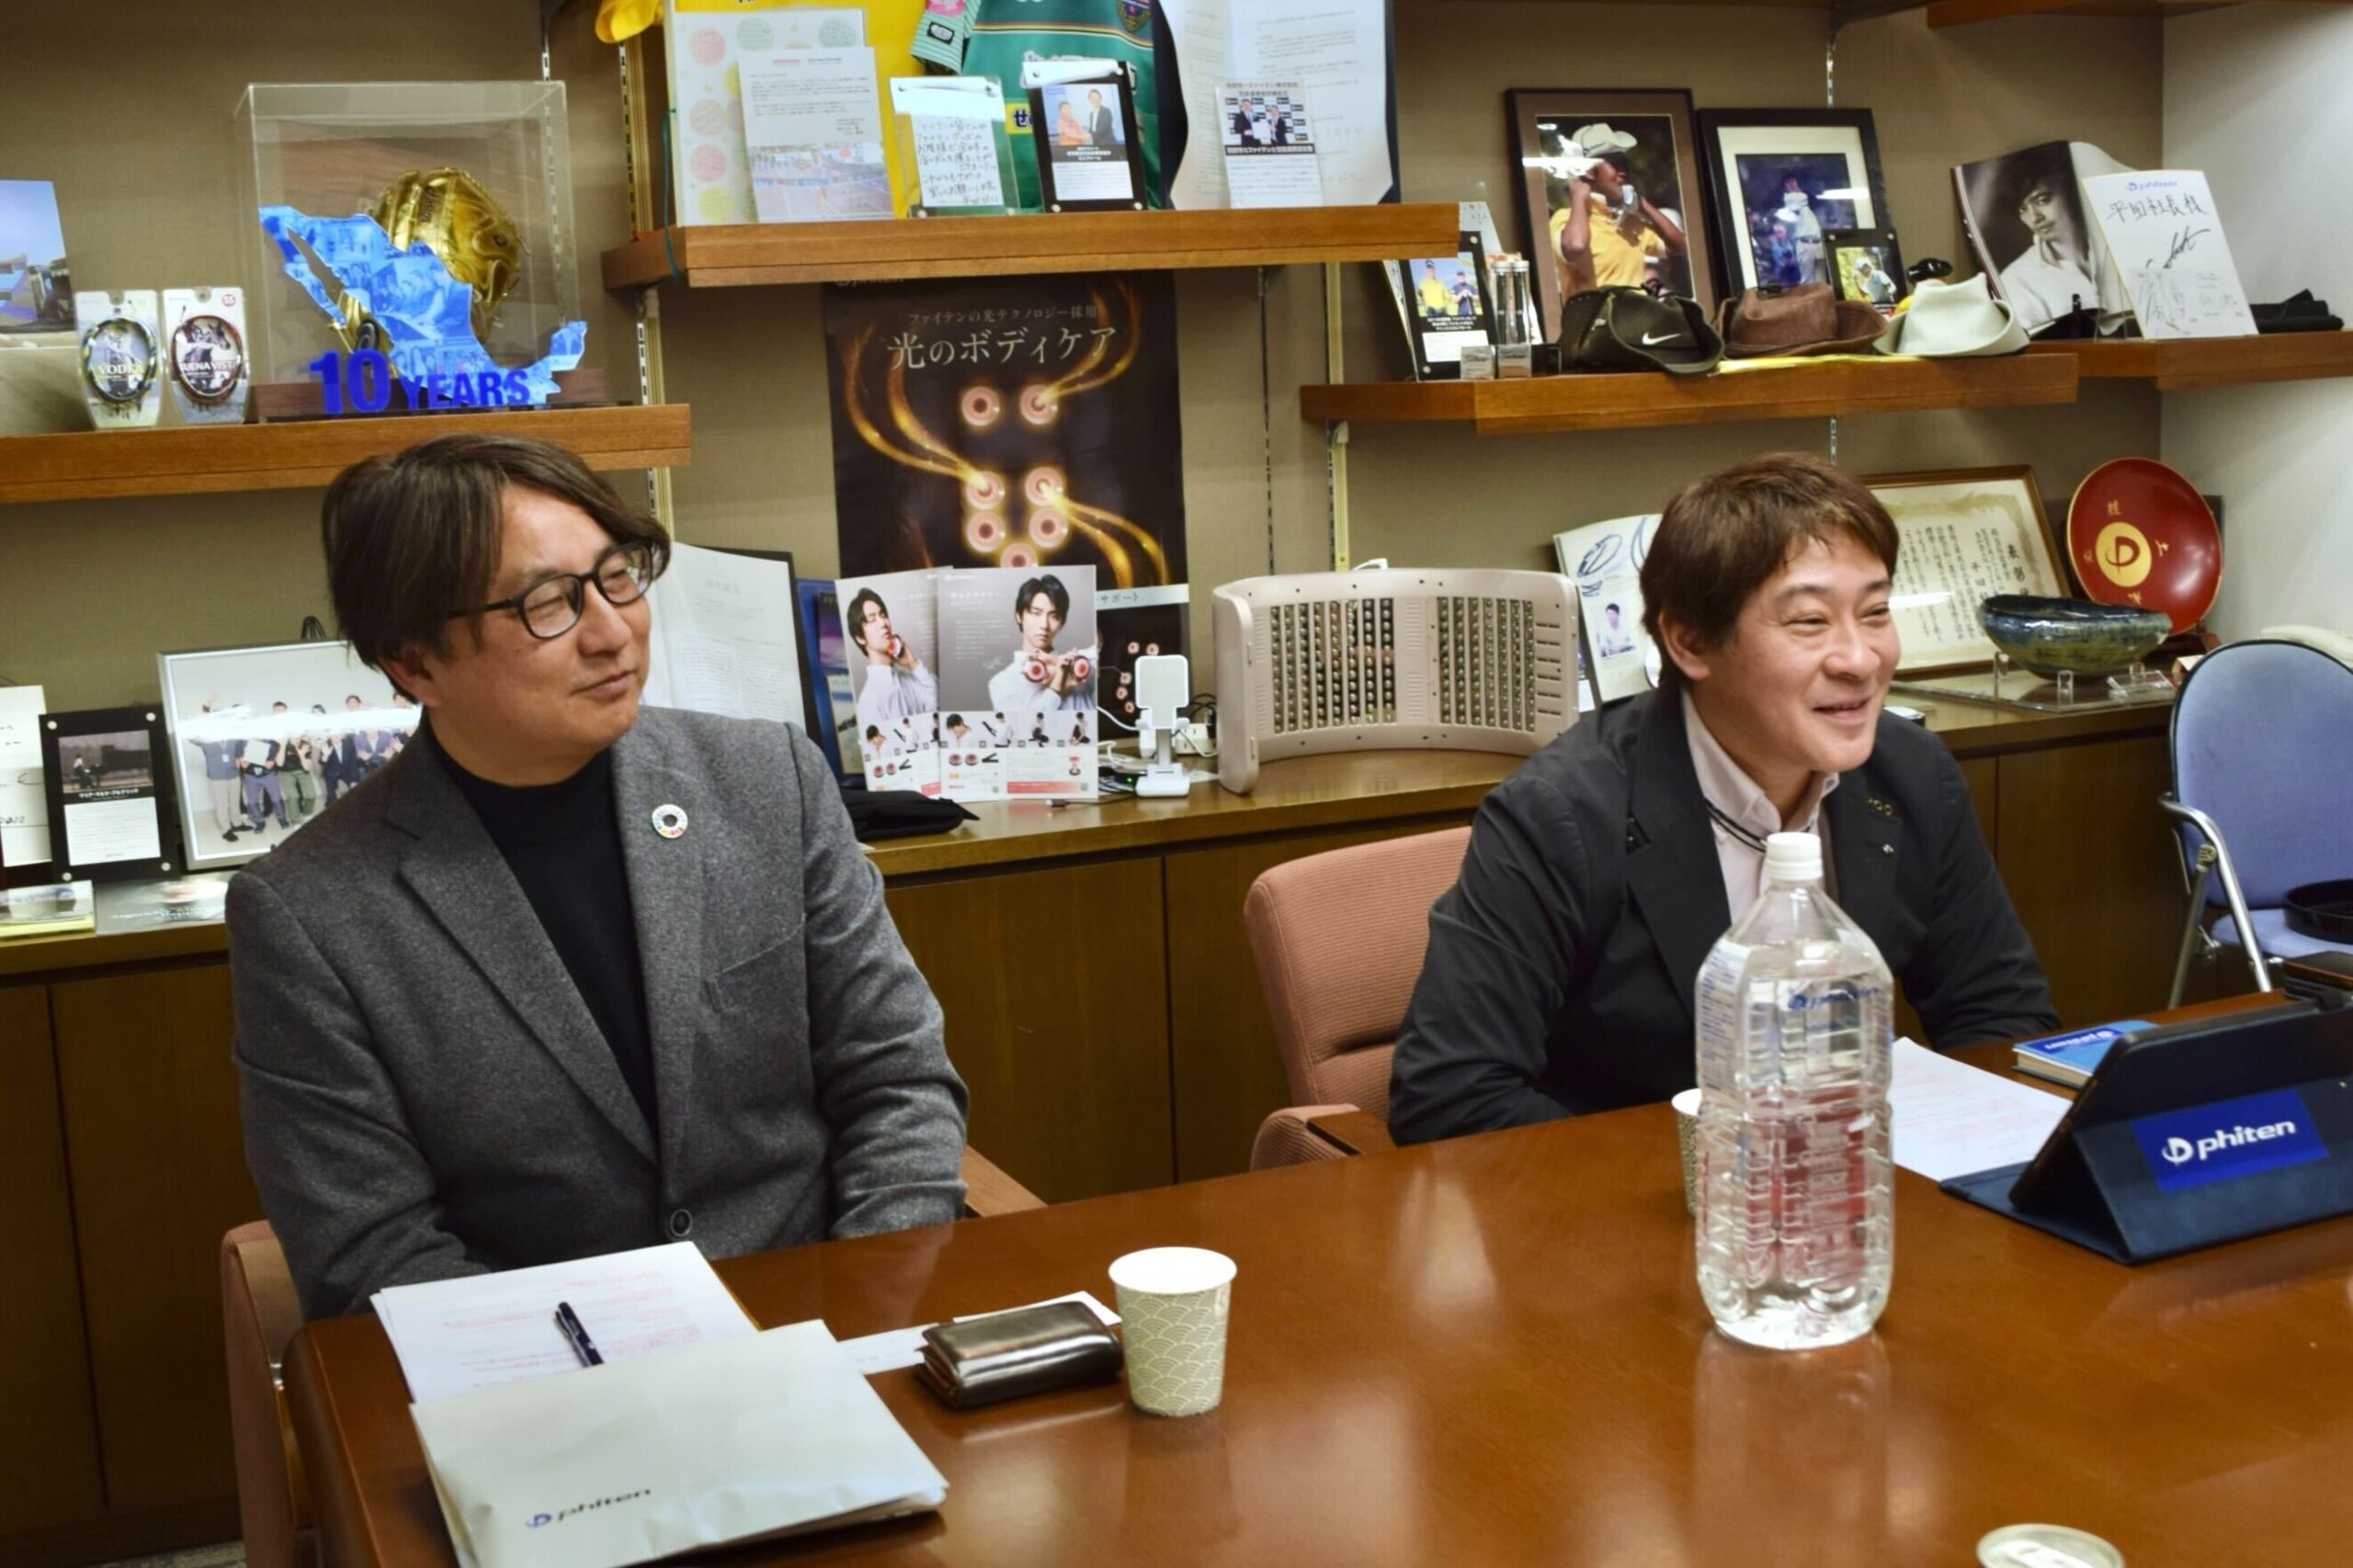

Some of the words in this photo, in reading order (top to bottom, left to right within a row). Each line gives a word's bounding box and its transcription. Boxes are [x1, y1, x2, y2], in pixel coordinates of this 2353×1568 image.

[1013, 108, 1033, 128] せ
[907, 304, 1097, 324] ファイテンの光テクノロジー採用
[886, 325, 1117, 370] 光のボディケア
[310, 349, 392, 415] 10
[399, 369, 530, 410] YEARS
[2198, 1120, 2297, 1161] phiten
[558, 1489, 651, 1522] phiten
